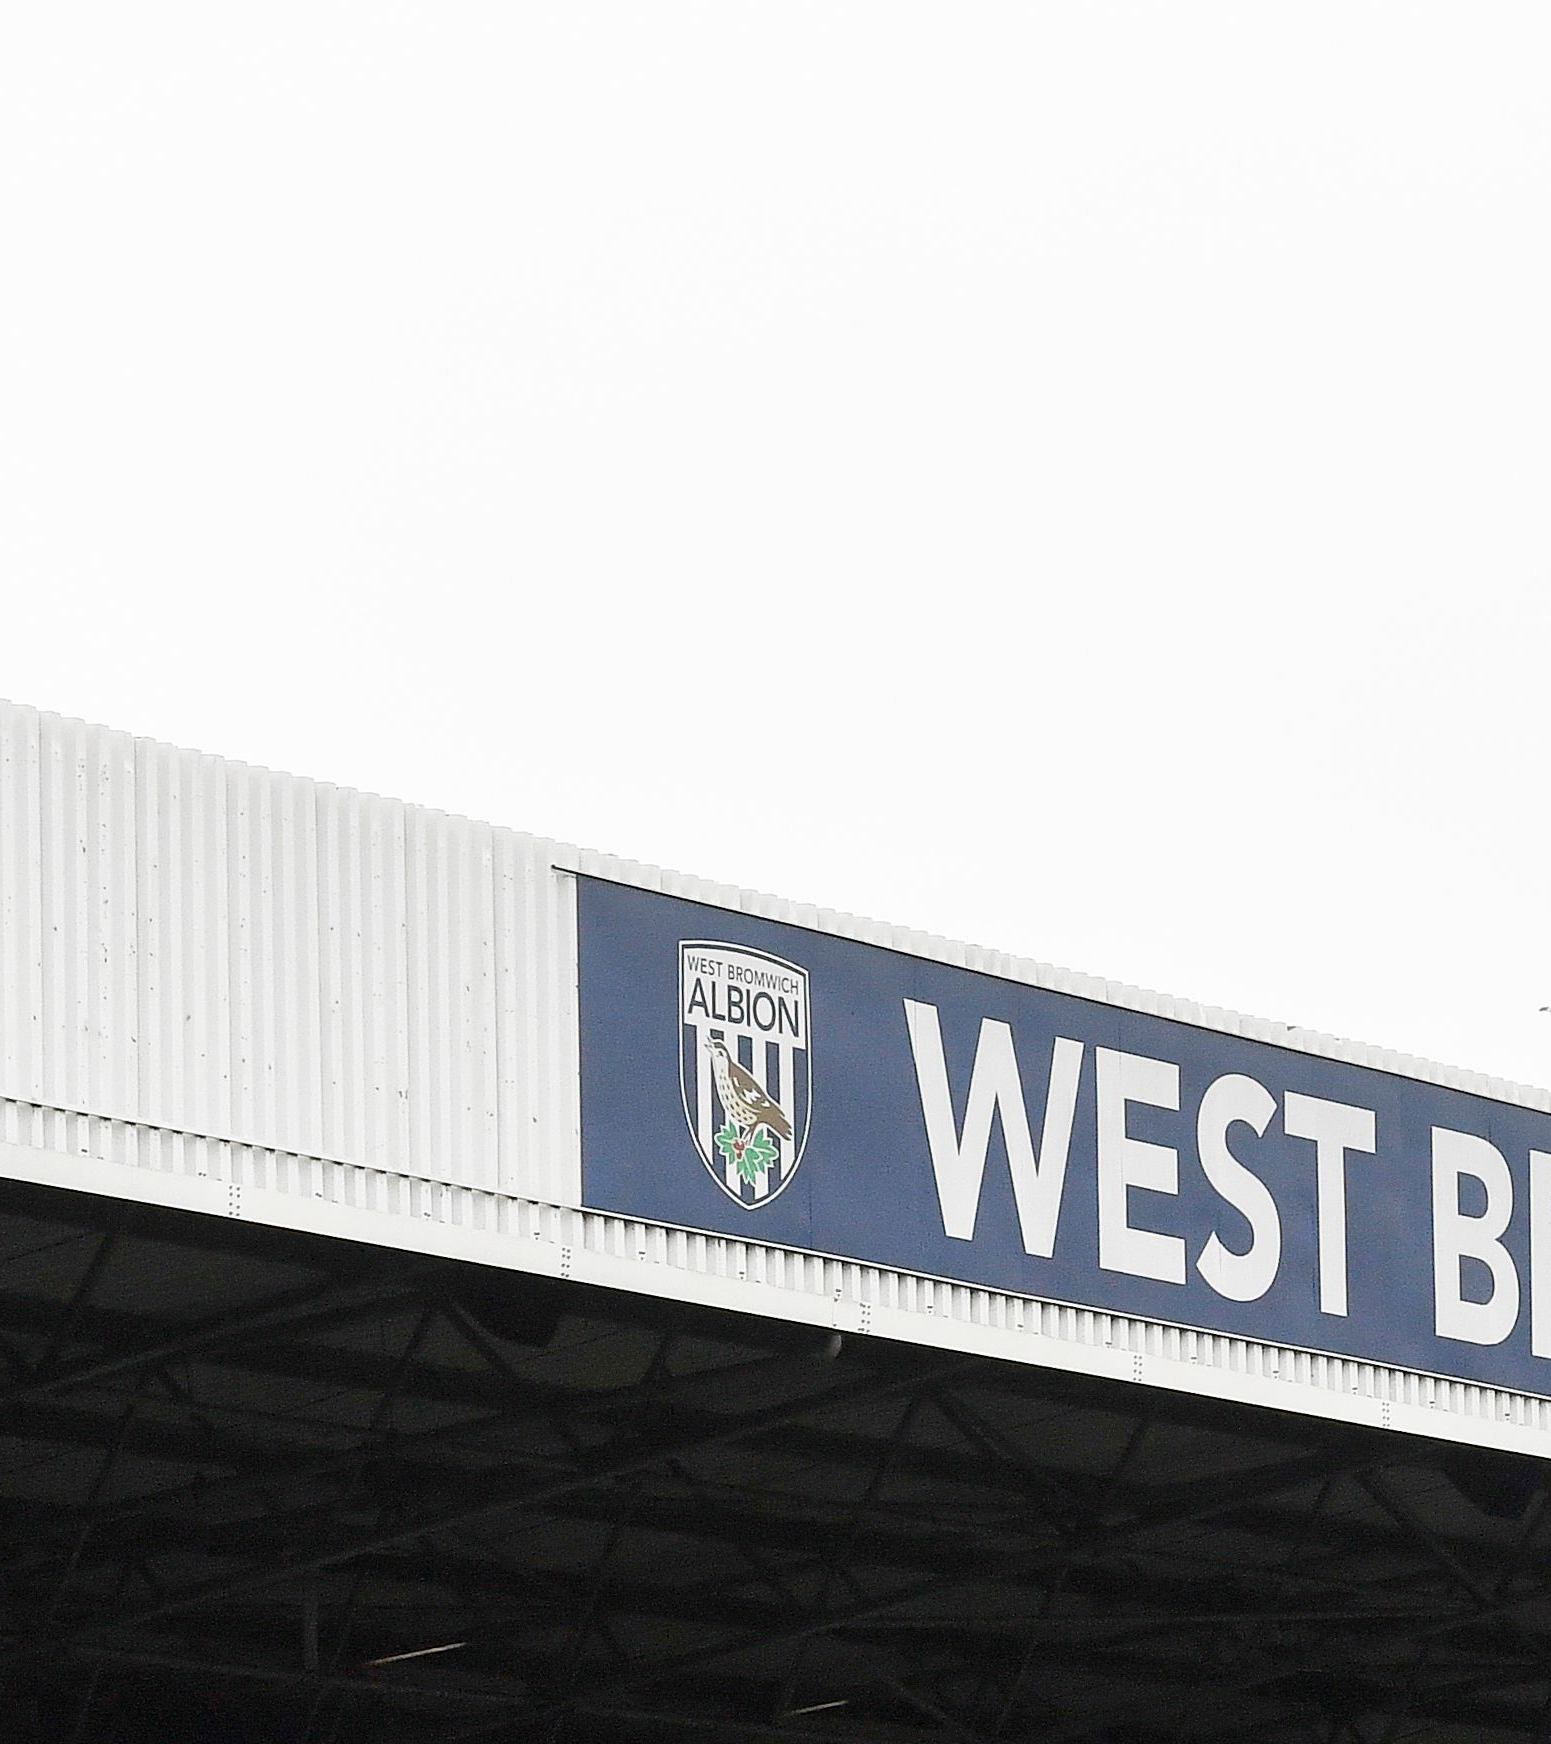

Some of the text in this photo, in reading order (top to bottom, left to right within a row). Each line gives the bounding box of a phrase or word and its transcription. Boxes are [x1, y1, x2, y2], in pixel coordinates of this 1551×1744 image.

[687, 954, 799, 996] WEST BROMWICH
[687, 977, 800, 1038] ALBION
[903, 997, 1378, 1318] WEST
